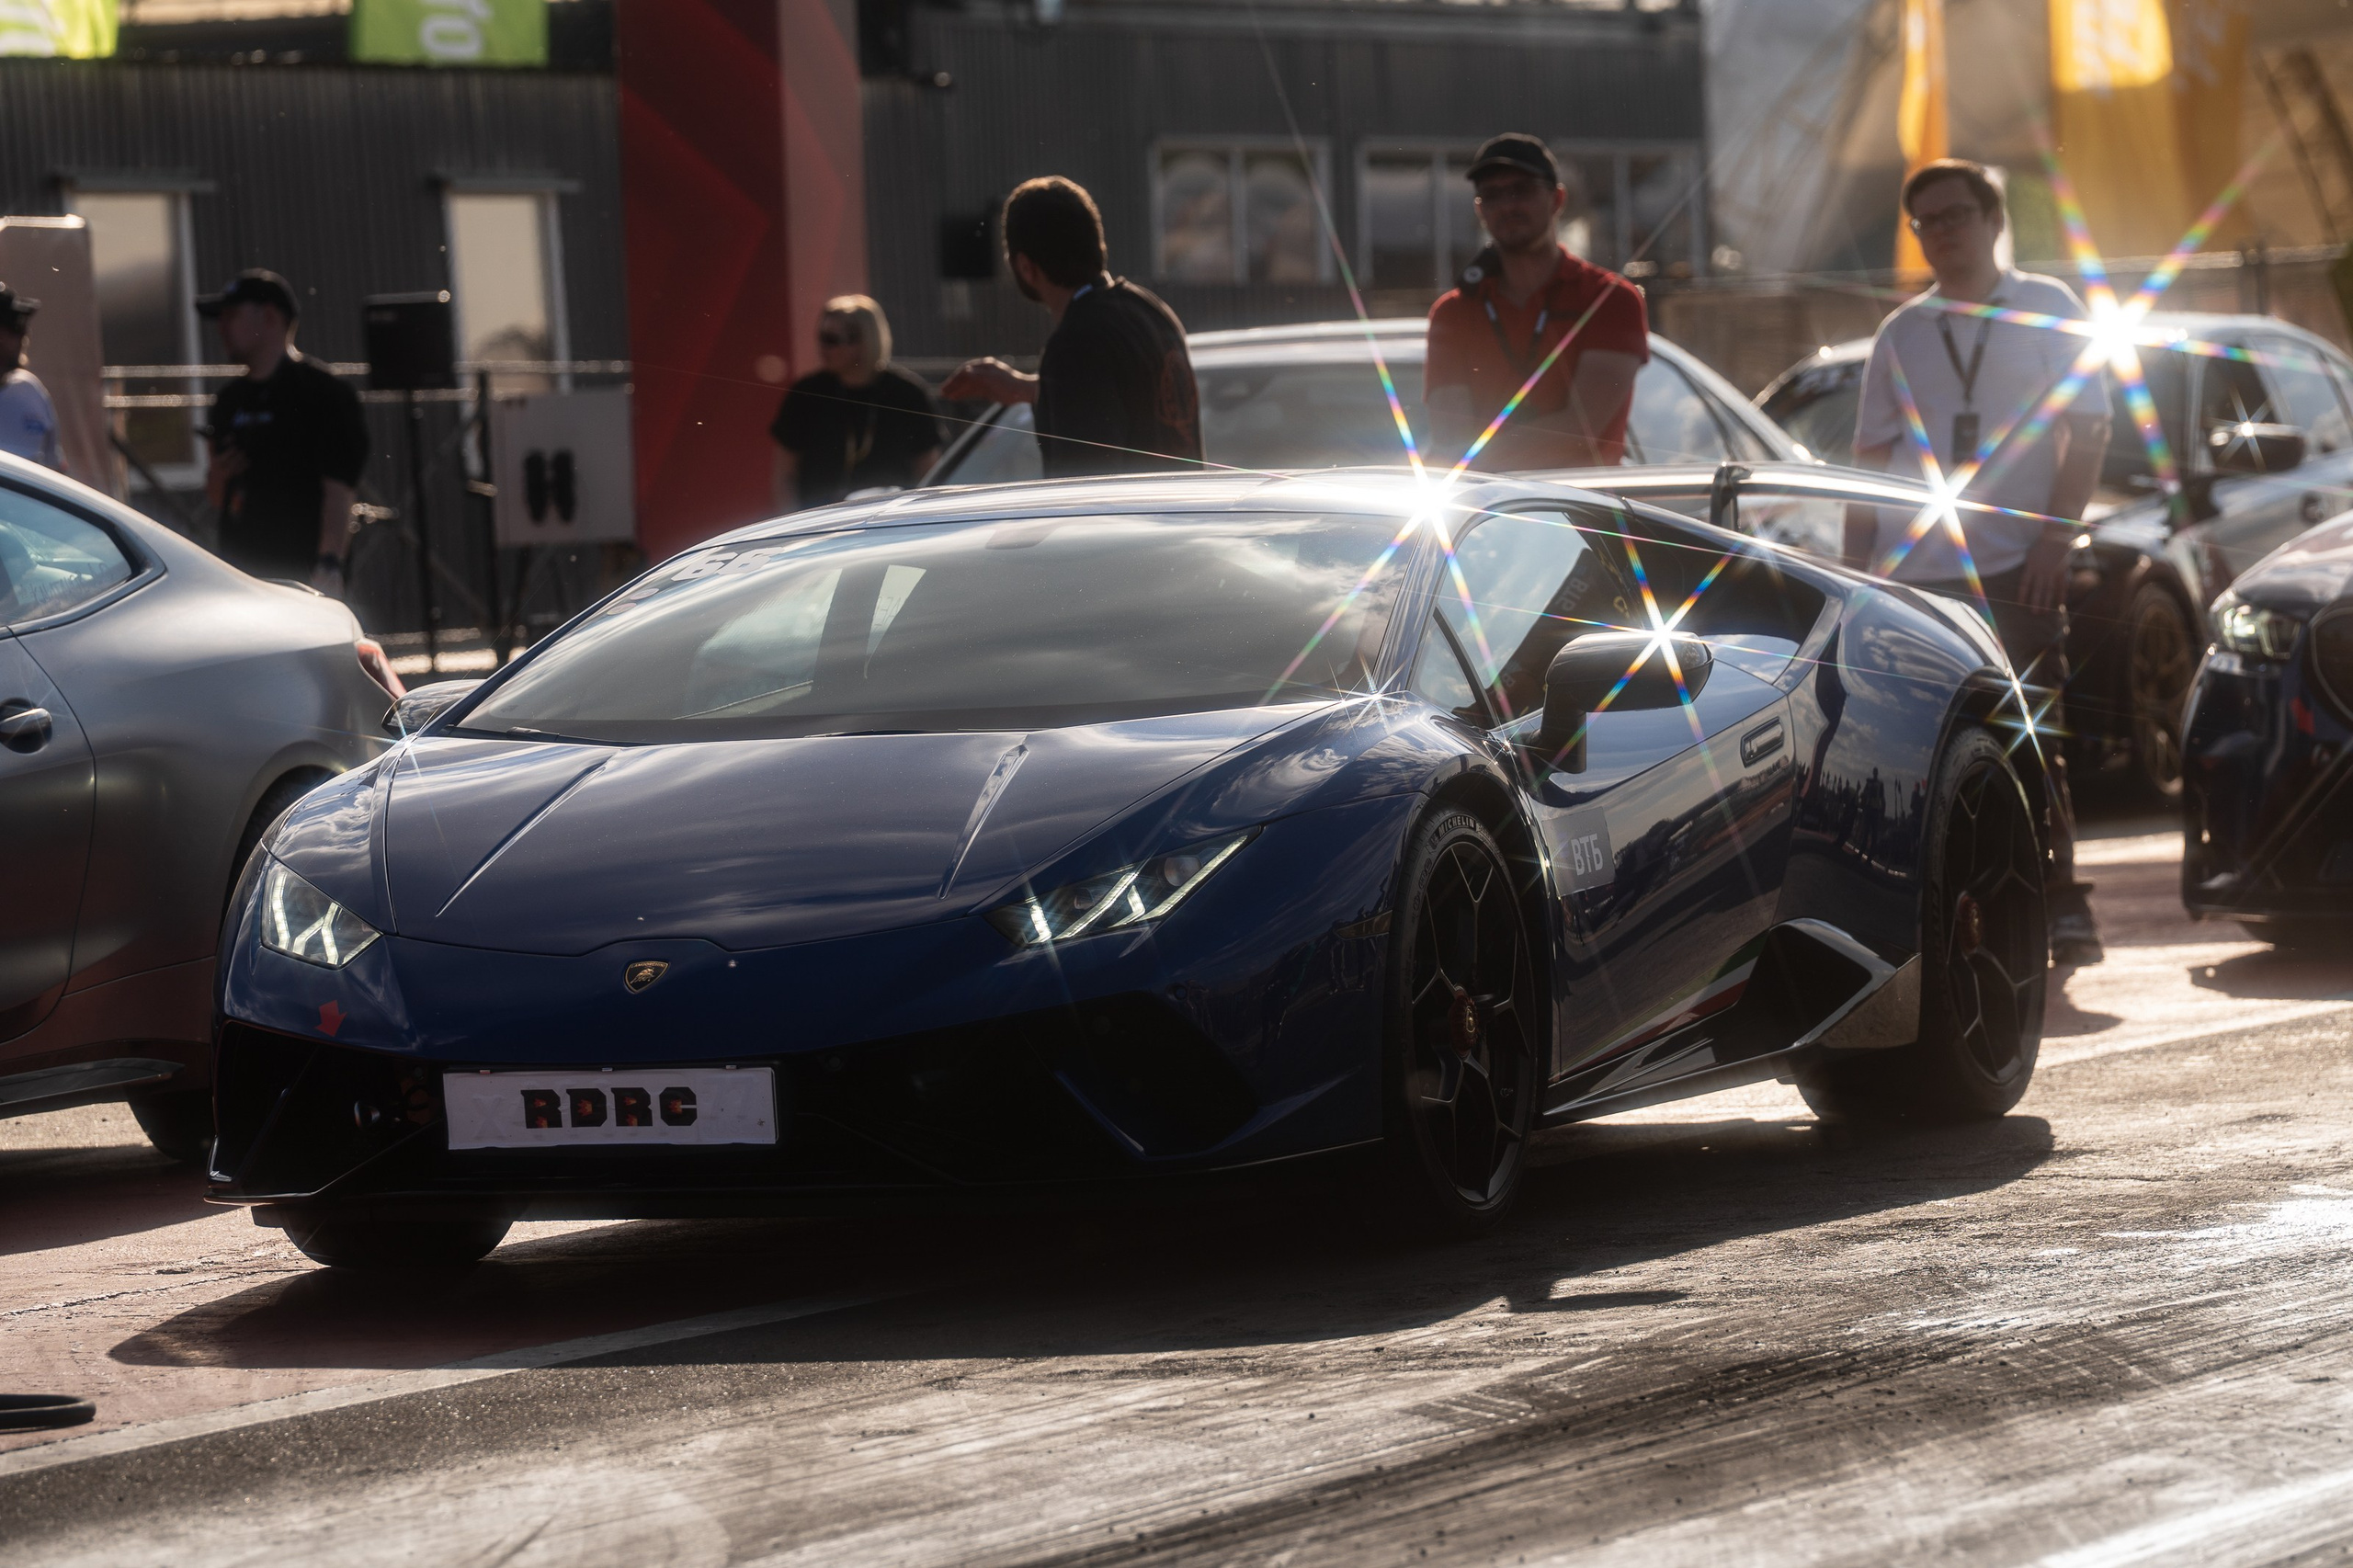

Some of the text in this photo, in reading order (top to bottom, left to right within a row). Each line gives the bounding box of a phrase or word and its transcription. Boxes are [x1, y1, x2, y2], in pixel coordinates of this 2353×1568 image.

[1438, 815, 1475, 837] MICHELIN
[1570, 833, 1604, 876] ВТБ
[520, 1086, 698, 1130] RDRC
